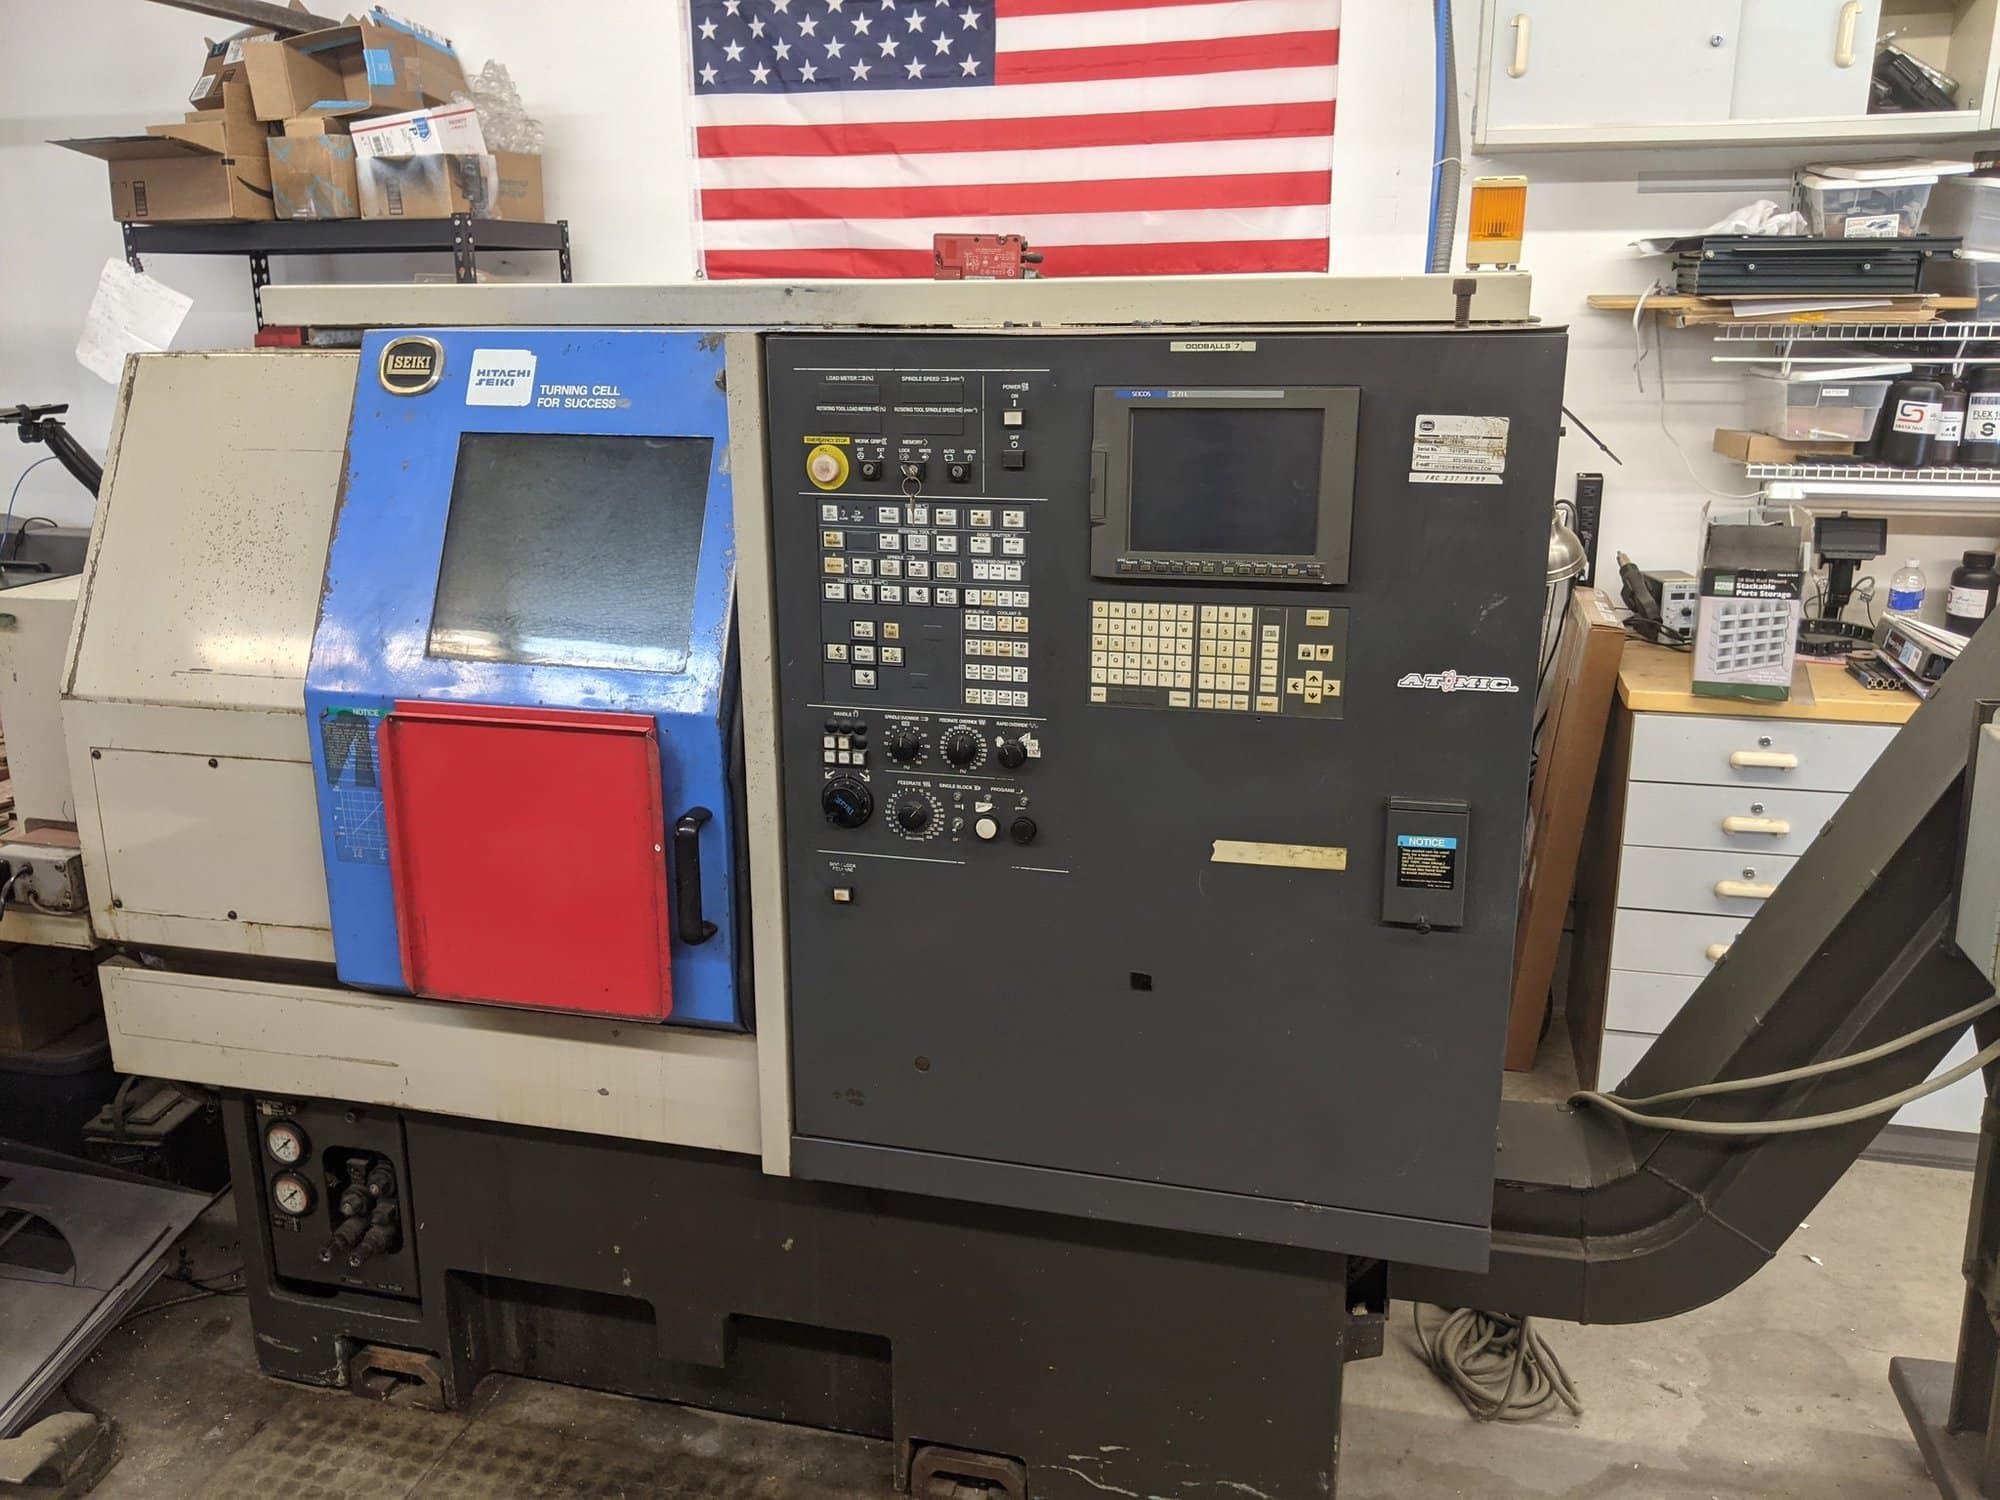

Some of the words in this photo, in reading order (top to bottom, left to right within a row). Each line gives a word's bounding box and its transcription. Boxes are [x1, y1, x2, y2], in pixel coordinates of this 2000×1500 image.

[393, 355, 430, 369] SEIKI
[476, 368, 532, 378] HITACHI
[475, 378, 515, 386] SEIKI
[540, 384, 588, 396] TURNING
[592, 385, 620, 396] CELL
[537, 398, 560, 408] FOR
[564, 398, 617, 410] SUCCESS
[1760, 590, 1792, 599] Storage
[353, 708, 379, 716] NOTICE
[1409, 838, 1445, 847] NOTICE
